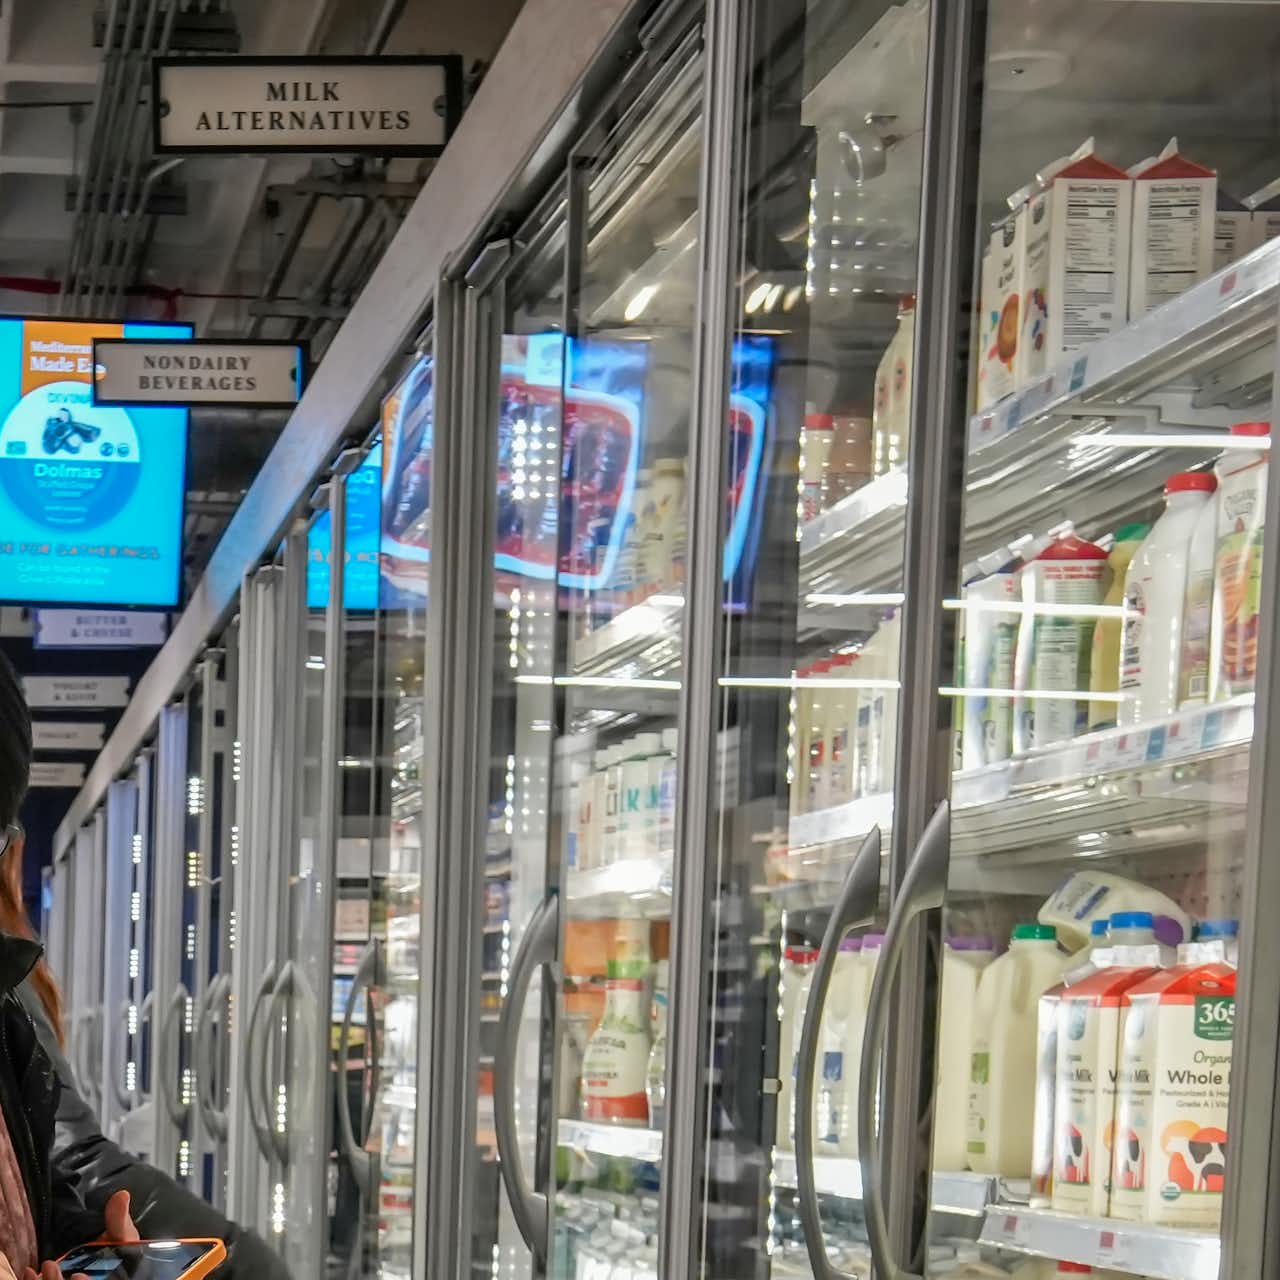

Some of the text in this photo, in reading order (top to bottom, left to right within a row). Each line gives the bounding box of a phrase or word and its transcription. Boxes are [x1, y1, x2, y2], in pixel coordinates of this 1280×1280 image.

[266, 81, 340, 102] MILK
[195, 110, 411, 131] ALTERNATIVES
[30, 355, 75, 372] Made
[143, 354, 253, 371] NONDAIRY
[138, 375, 258, 392] BEVERAGES
[33, 463, 103, 479] Dolmas
[1167, 1069, 1223, 1085] Whole
